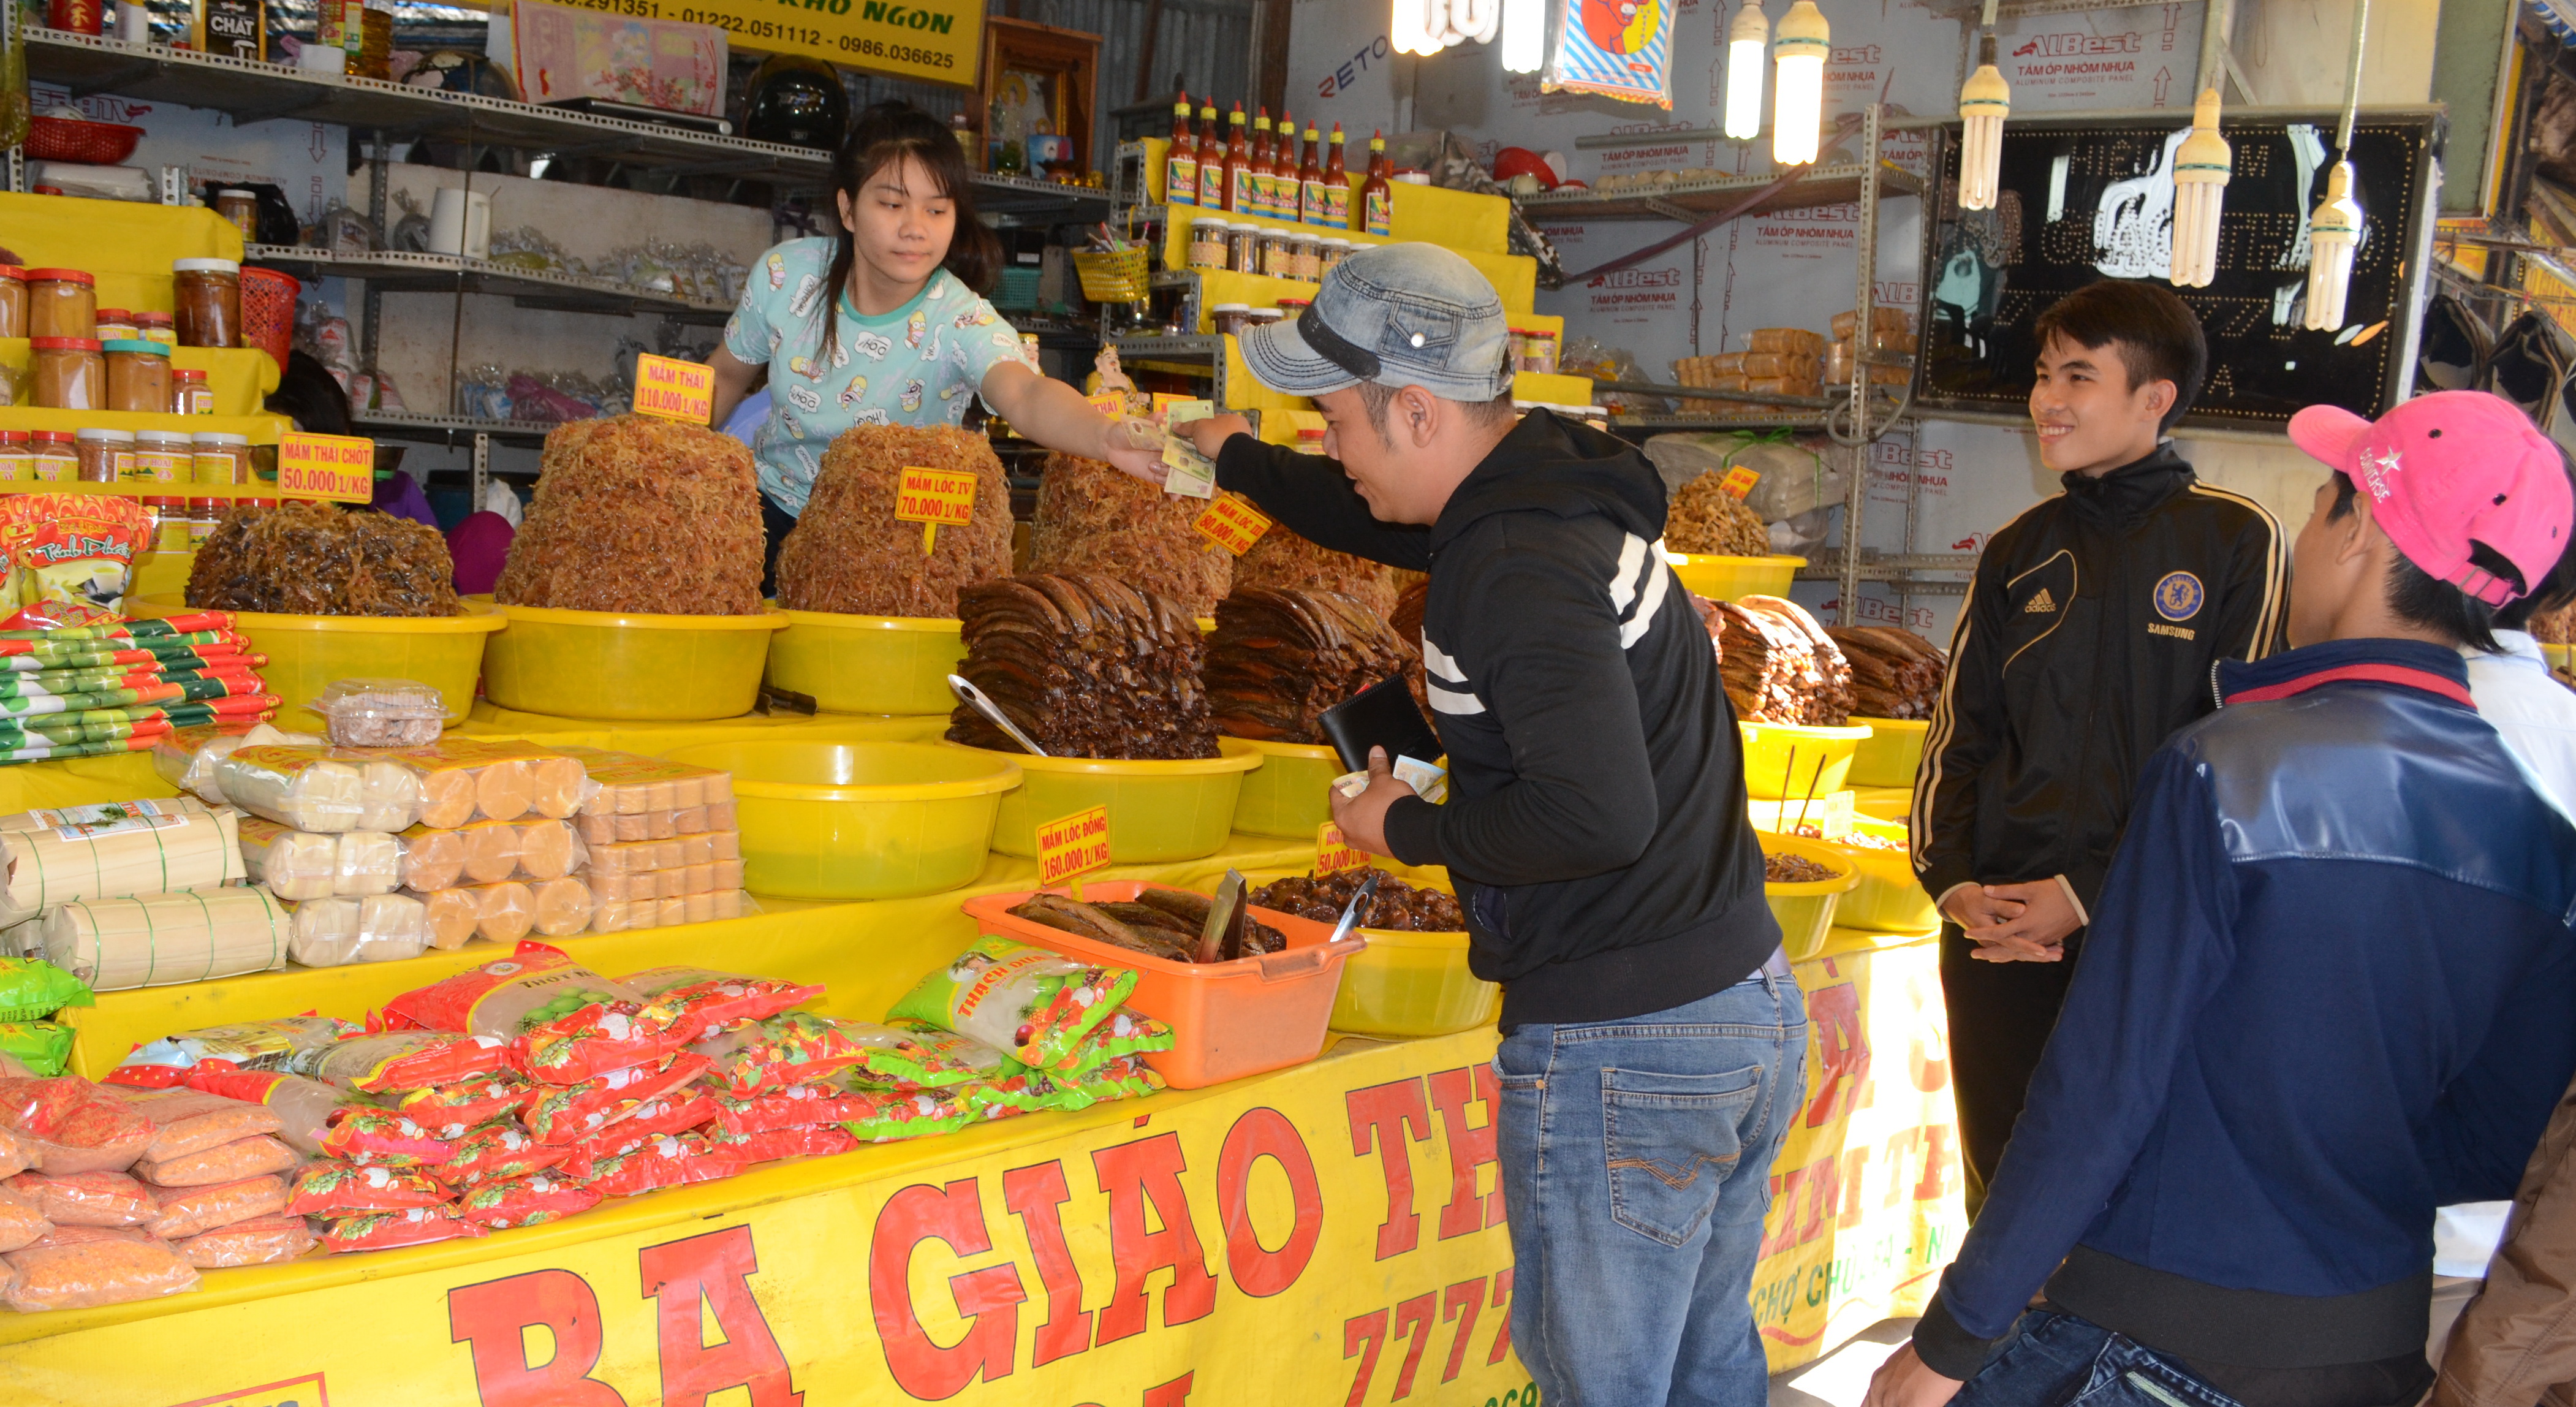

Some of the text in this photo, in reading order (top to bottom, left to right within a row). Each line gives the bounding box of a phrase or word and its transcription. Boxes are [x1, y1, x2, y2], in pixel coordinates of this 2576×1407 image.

[862, 1, 954, 35] NGON
[839, 35, 955, 69] 0986.036625
[2015, 74, 2134, 86] ALUMINUM COMPOSITE PANEL
[679, 370, 705, 390] THÁI
[640, 386, 682, 412] 110.000
[314, 442, 339, 463] THÁI
[284, 468, 336, 493] 50.000
[957, 482, 972, 495] IV
[901, 496, 943, 517] 70.000
[1199, 514, 1234, 541] 80.000
[2024, 602, 2057, 613] adidas
[2147, 622, 2196, 641] SAMSUNG
[1064, 821, 1081, 844] LÓC
[1044, 848, 1083, 881] 160.000
[1318, 849, 1351, 874] 50.000
[868, 1106, 1324, 1401] GIÁO
